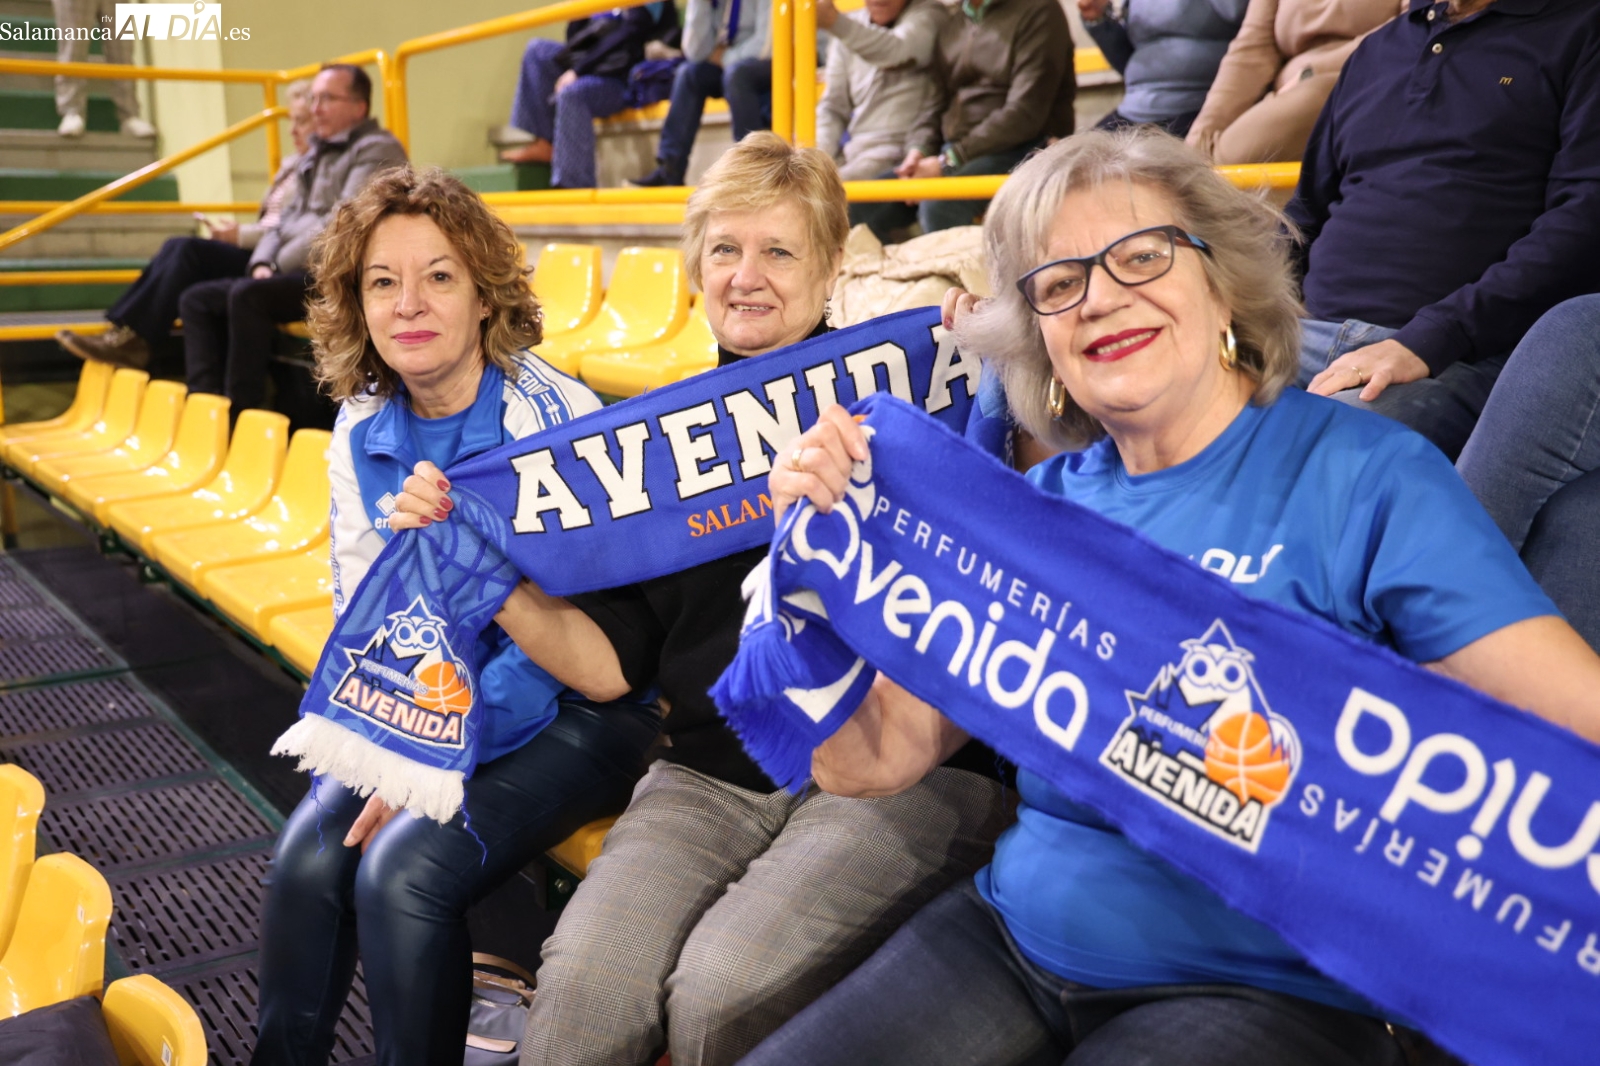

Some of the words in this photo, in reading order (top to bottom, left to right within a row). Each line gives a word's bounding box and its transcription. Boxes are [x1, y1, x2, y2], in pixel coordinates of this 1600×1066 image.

[510, 322, 982, 535] AVENIDA
[873, 496, 1117, 661] PERFUMERÍAS
[338, 676, 460, 741] AVENIDA
[1110, 729, 1264, 841] AVENIDA
[1334, 686, 1600, 895] nida
